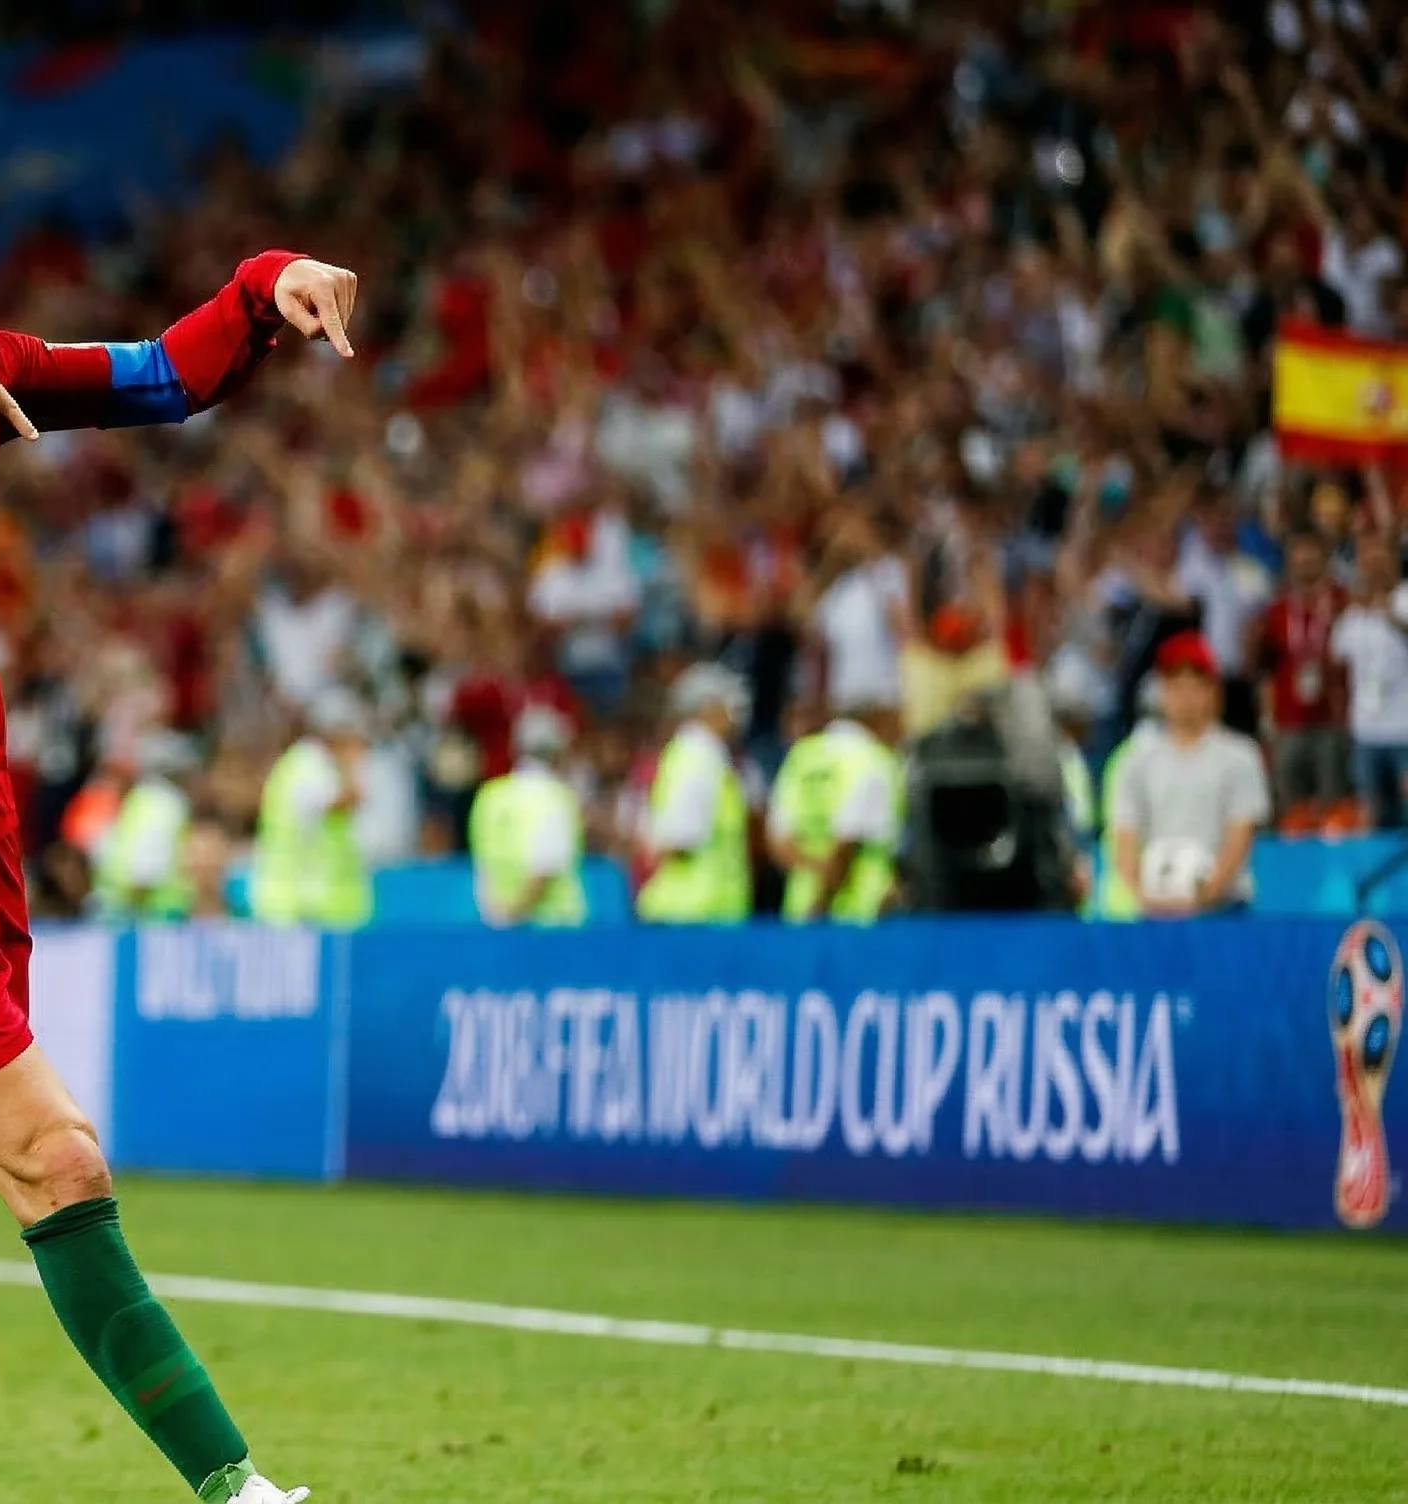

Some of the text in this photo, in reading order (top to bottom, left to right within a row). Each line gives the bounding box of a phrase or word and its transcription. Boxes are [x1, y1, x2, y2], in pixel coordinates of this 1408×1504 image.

[648, 987, 840, 1151] WORLD
[842, 989, 962, 1158] CUP
[963, 990, 1180, 1166] RUSSIA
